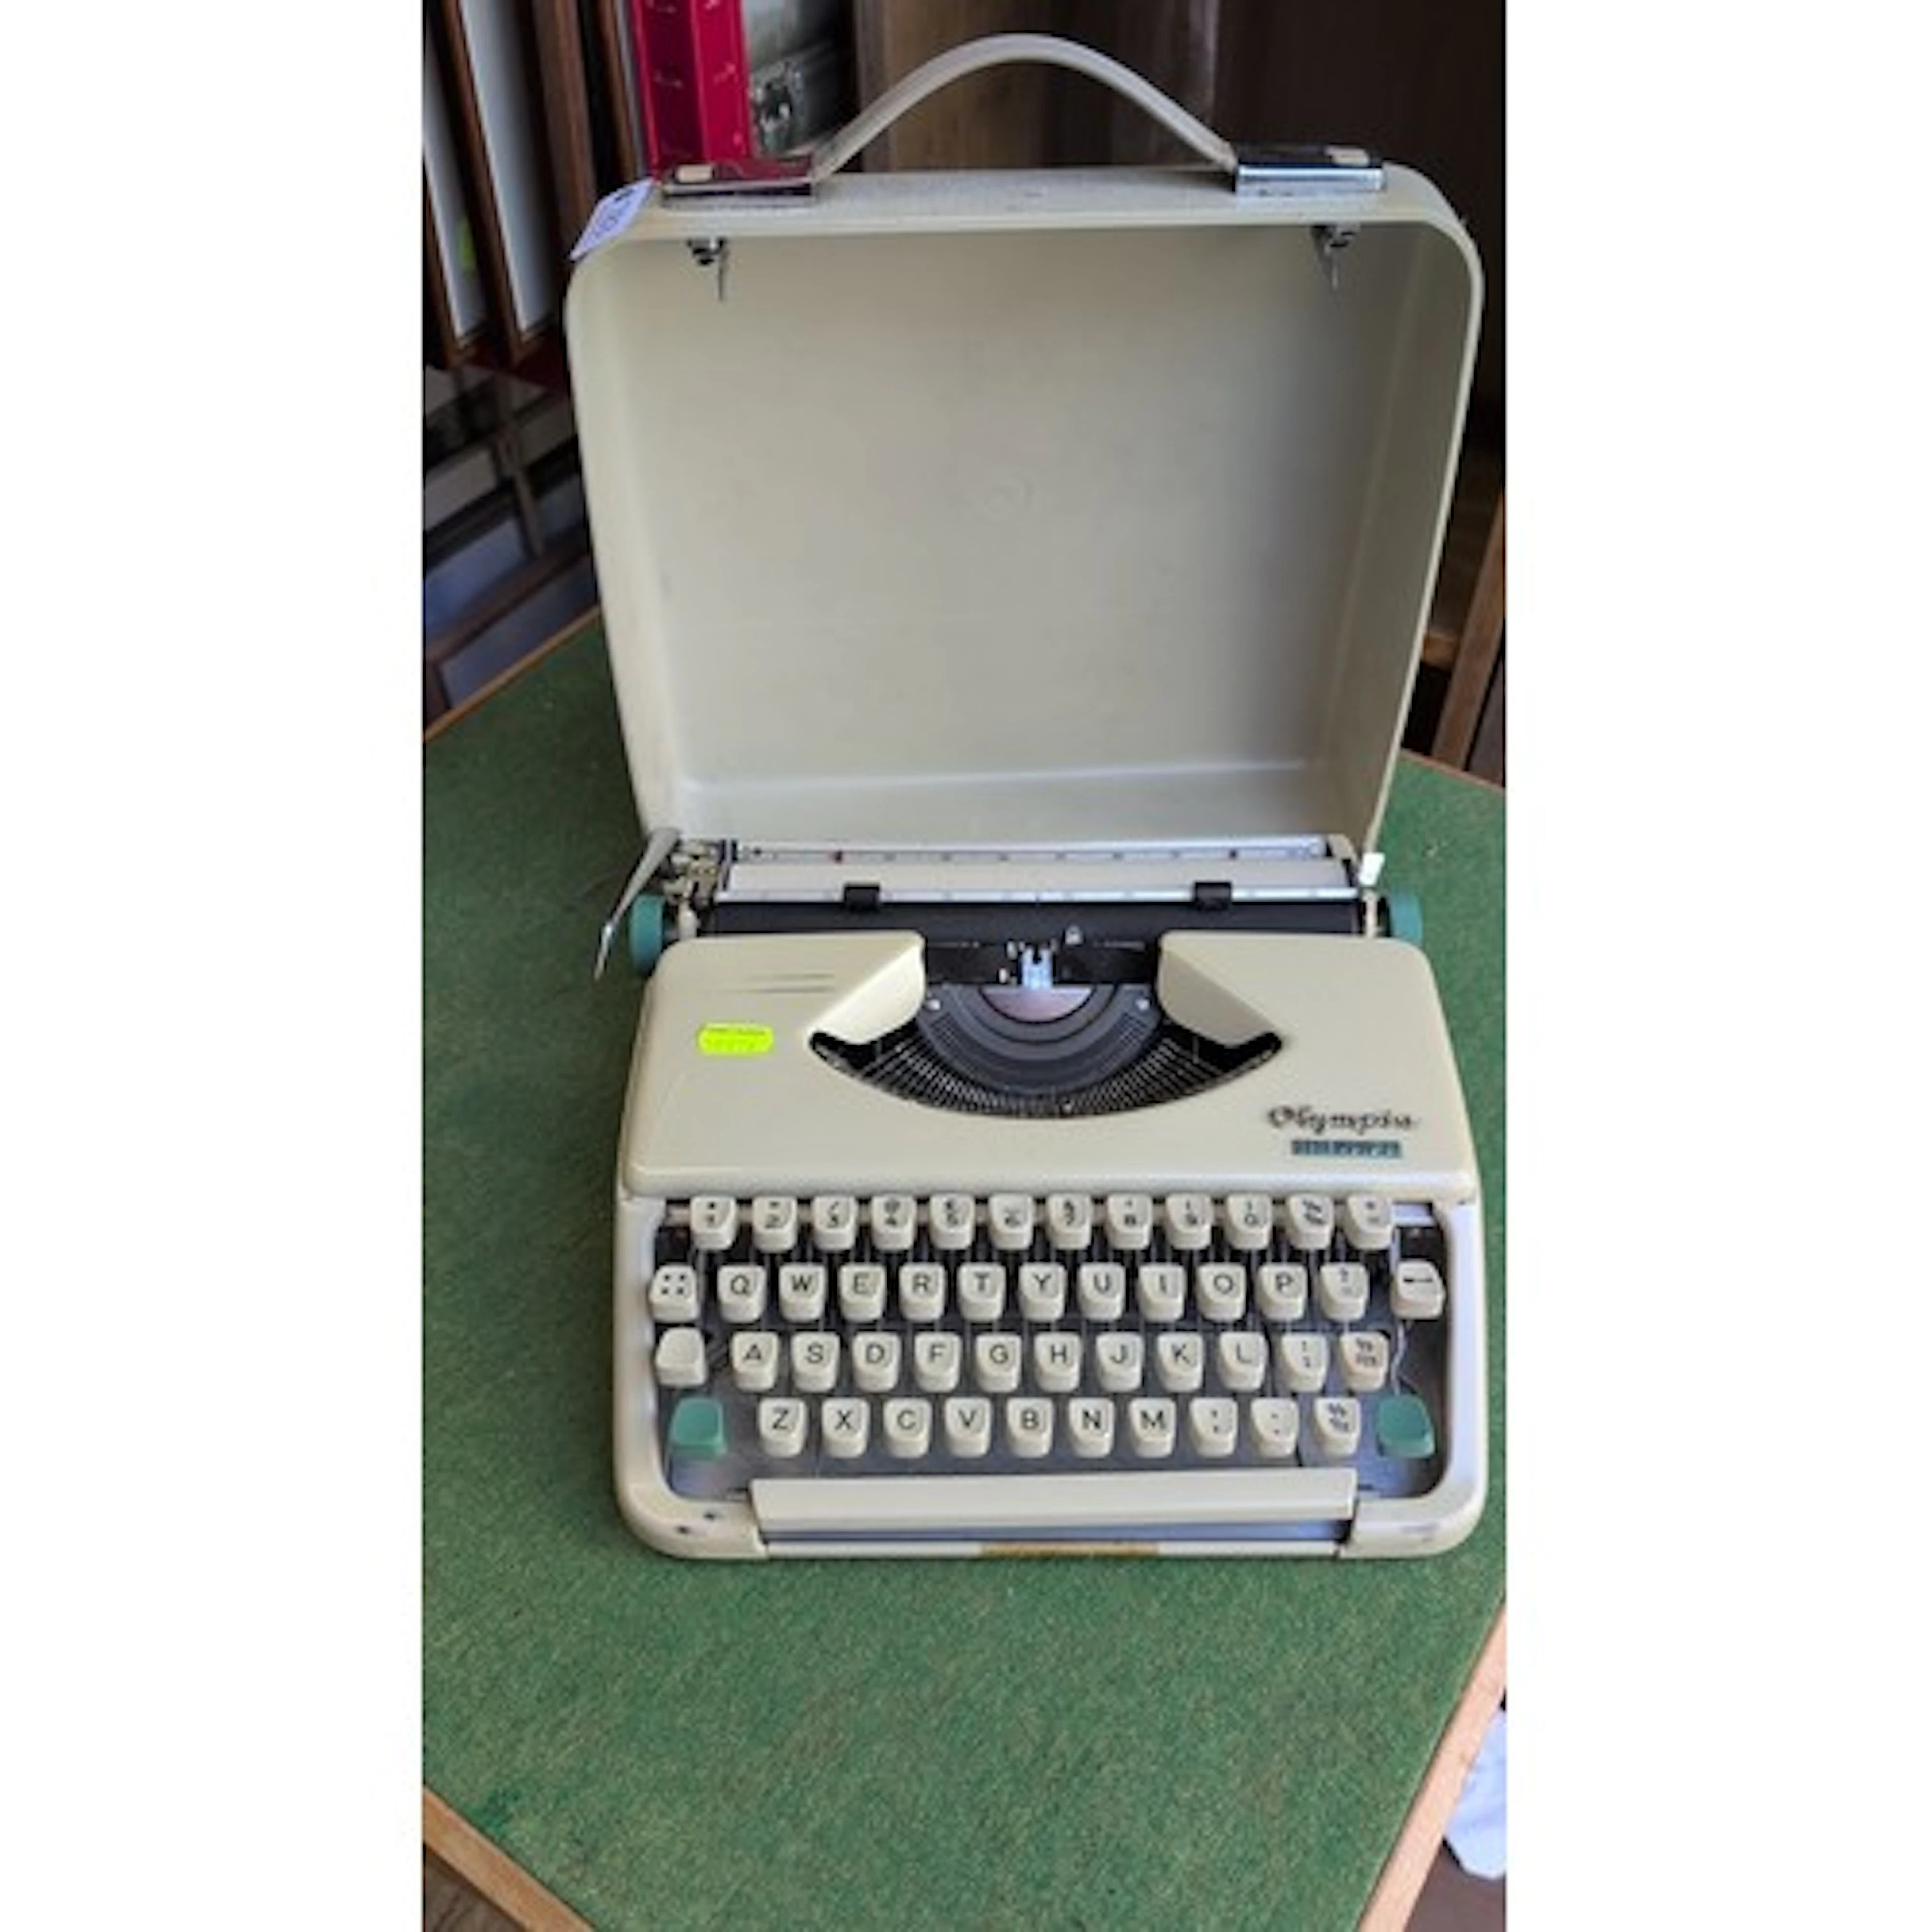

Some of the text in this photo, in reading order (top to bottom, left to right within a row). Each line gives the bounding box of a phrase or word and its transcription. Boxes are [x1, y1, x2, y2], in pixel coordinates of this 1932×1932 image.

[1267, 1105, 1420, 1136] Olympia
[729, 1271, 1295, 1297] Q W E R T Y U I O P
[743, 1342, 1253, 1366] A S D F G H J K L
[771, 1407, 1167, 1431] Z X C V B N M
